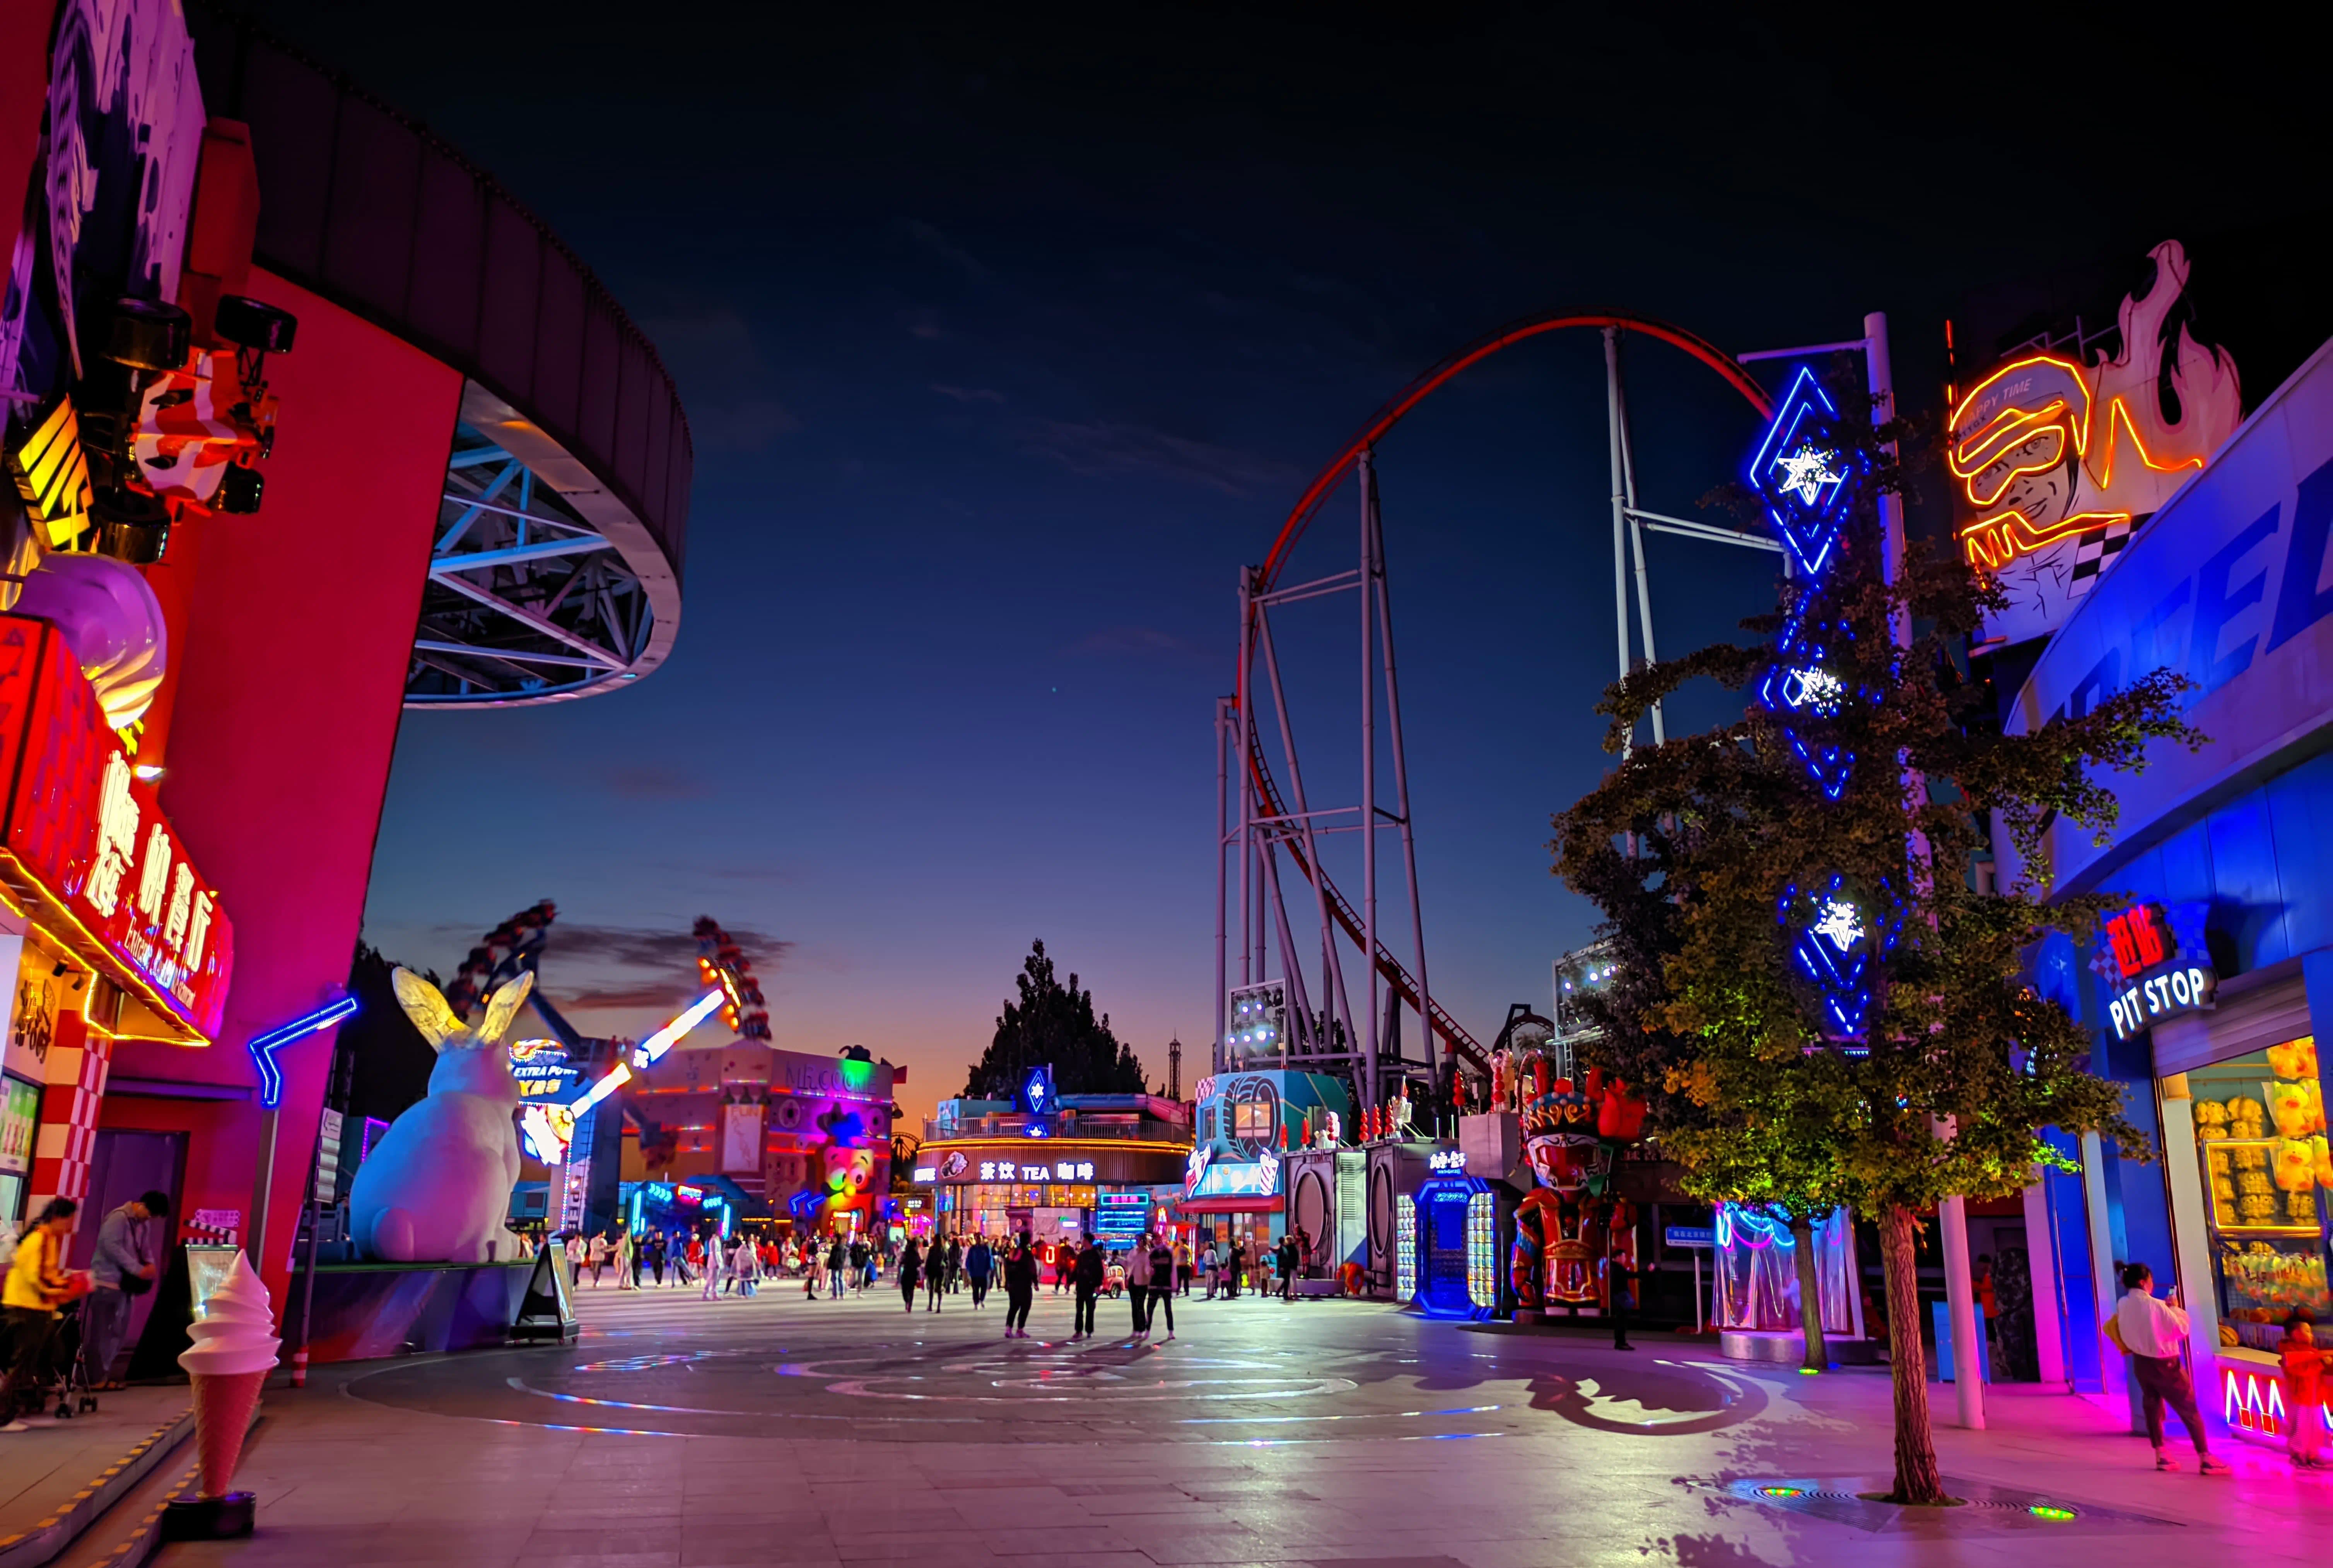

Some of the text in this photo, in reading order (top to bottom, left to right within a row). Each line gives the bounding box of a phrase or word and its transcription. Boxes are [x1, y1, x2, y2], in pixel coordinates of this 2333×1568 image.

[2002, 377, 2033, 401] TIME
[2109, 968, 2204, 1040] PIT STOP
[514, 1066, 547, 1077] EXTRA
[980, 1162, 1093, 1181] 茶饮 TEA 咖啡
